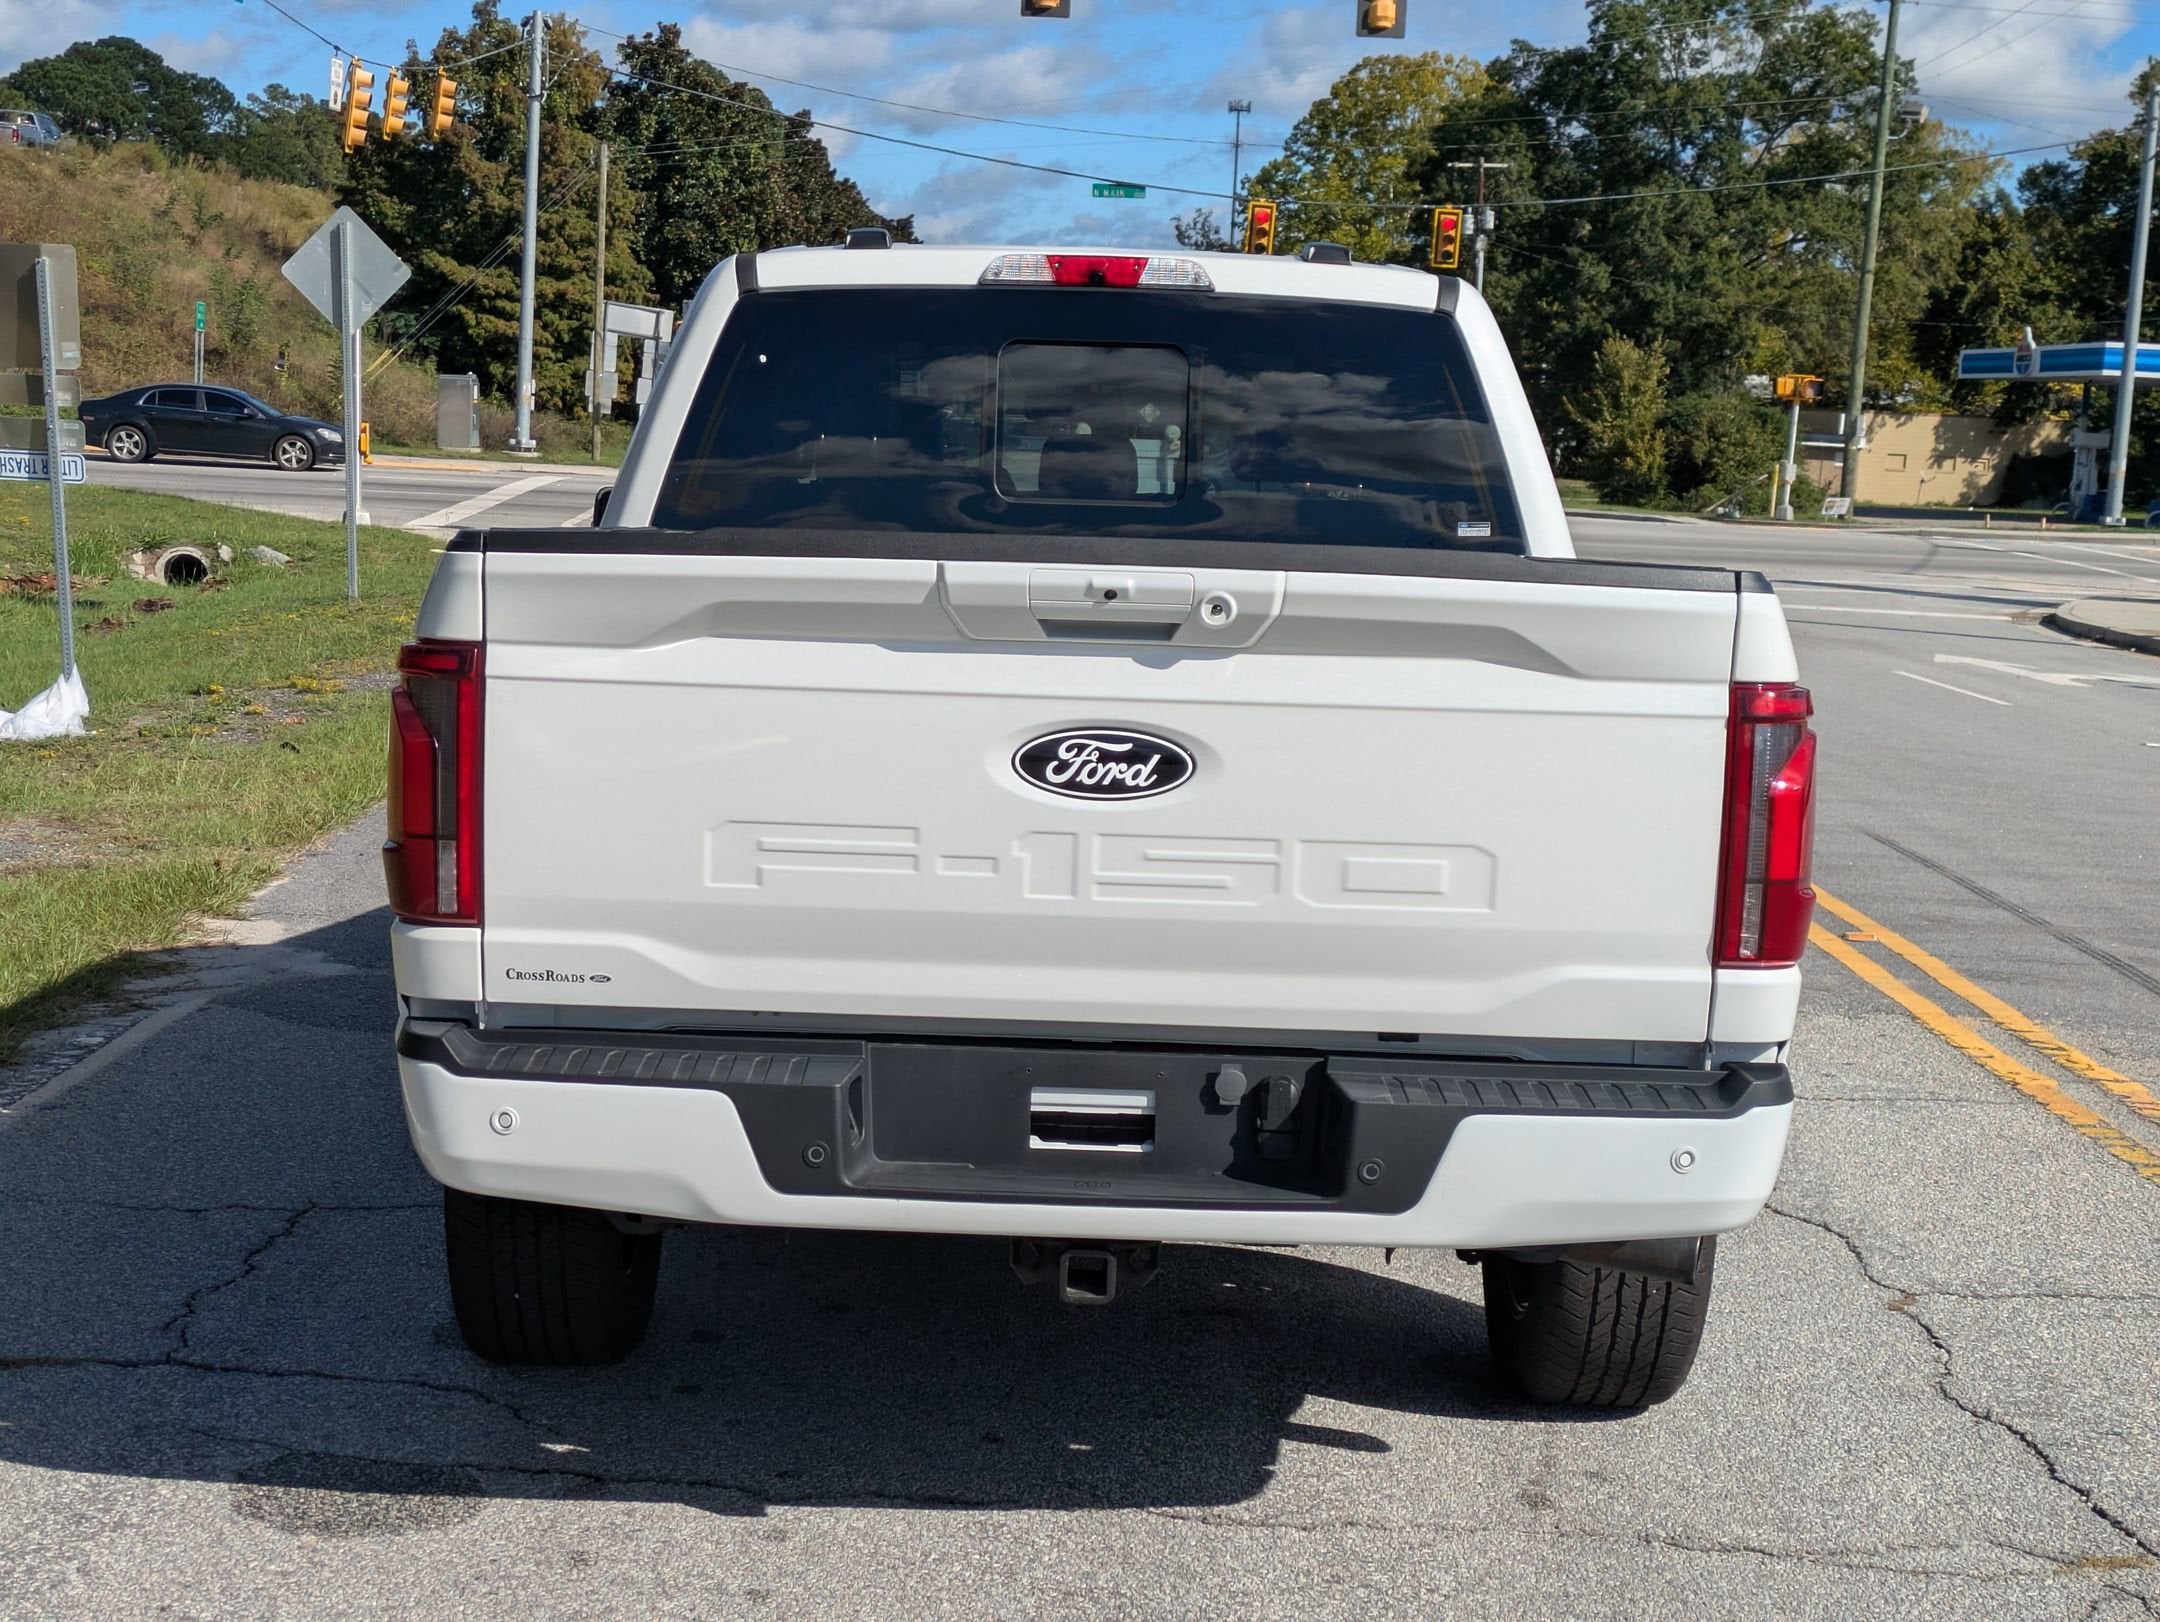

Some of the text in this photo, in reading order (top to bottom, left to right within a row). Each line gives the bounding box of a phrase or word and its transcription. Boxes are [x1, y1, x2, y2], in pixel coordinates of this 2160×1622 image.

[1103, 188, 1125, 199] MAIN
[41, 457, 79, 477] LITR
[1046, 738, 1161, 787] Ford
[703, 820, 1496, 913] F-150
